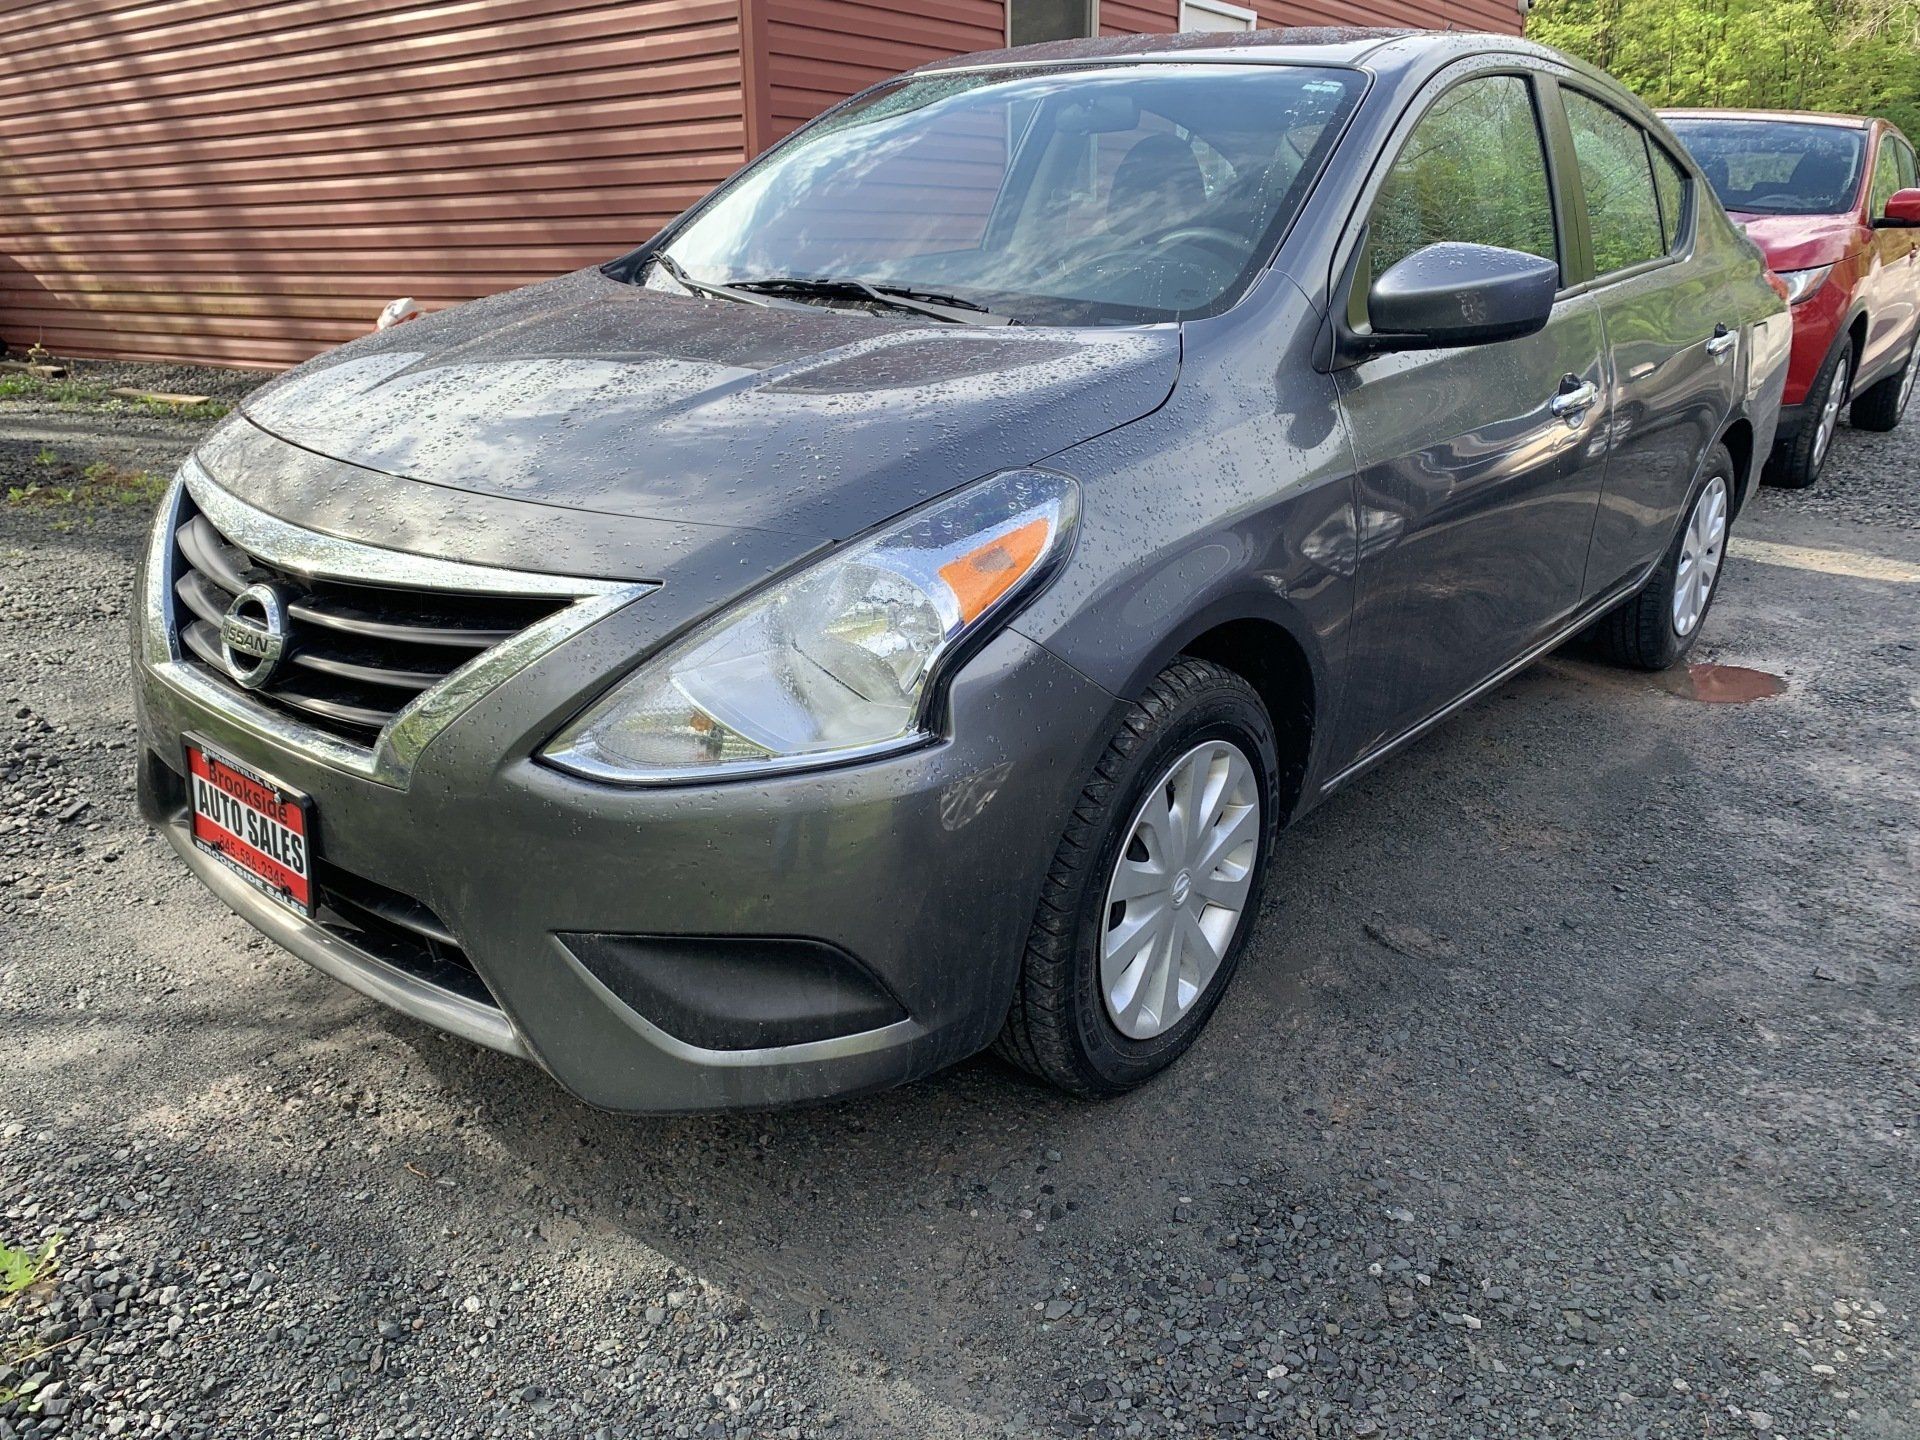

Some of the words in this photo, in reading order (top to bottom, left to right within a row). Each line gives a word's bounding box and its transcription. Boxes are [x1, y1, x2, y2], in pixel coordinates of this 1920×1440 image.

[198, 779, 243, 837] AUTO
[246, 809, 305, 875] SALES
[208, 762, 288, 825] Brookside
[196, 840, 263, 890] BROOKSIDE
[266, 885, 308, 917] SALES
